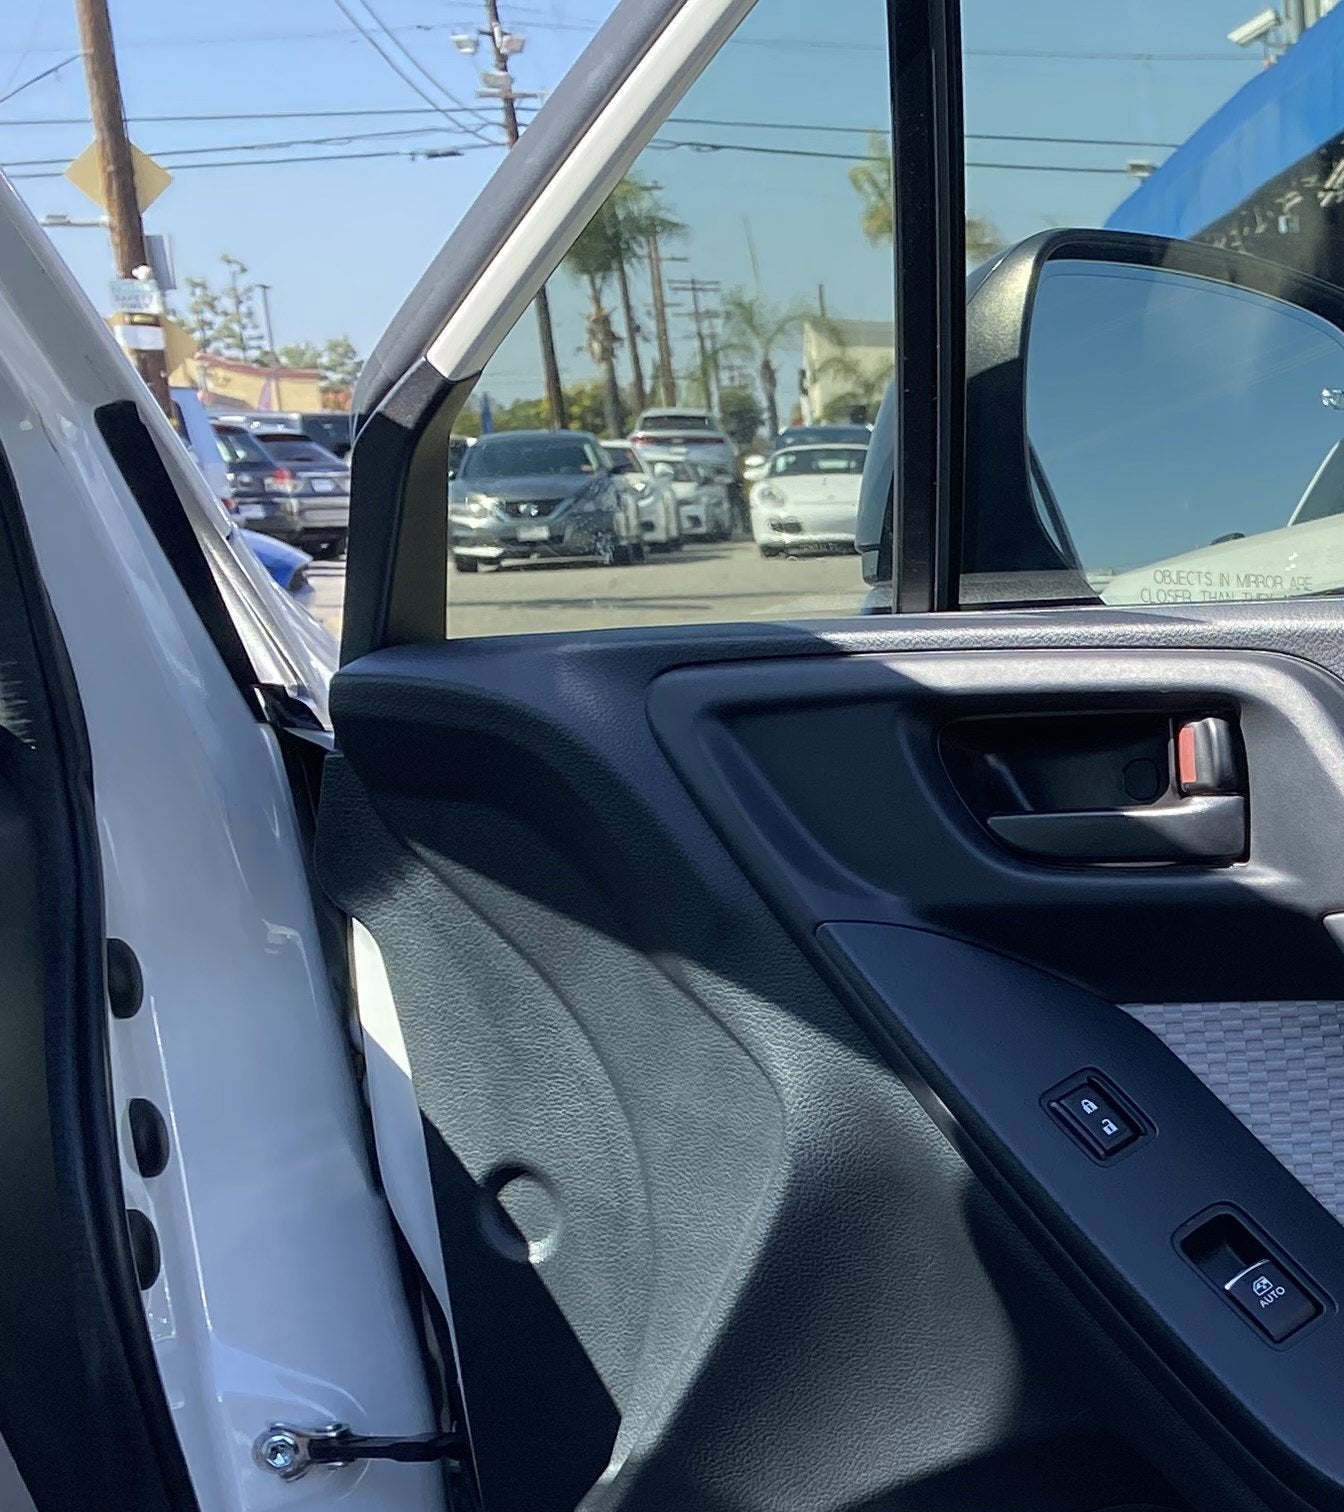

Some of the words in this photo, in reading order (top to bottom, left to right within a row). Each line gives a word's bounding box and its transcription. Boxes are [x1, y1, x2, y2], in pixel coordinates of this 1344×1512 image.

[1153, 569, 1213, 587] OBJECTS
[1219, 573, 1231, 588] IN
[1236, 573, 1284, 590] MIRROR
[1289, 576, 1313, 592] ARE
[1140, 588, 1192, 603] CLOSER
[1260, 1286, 1285, 1308] AUTO
